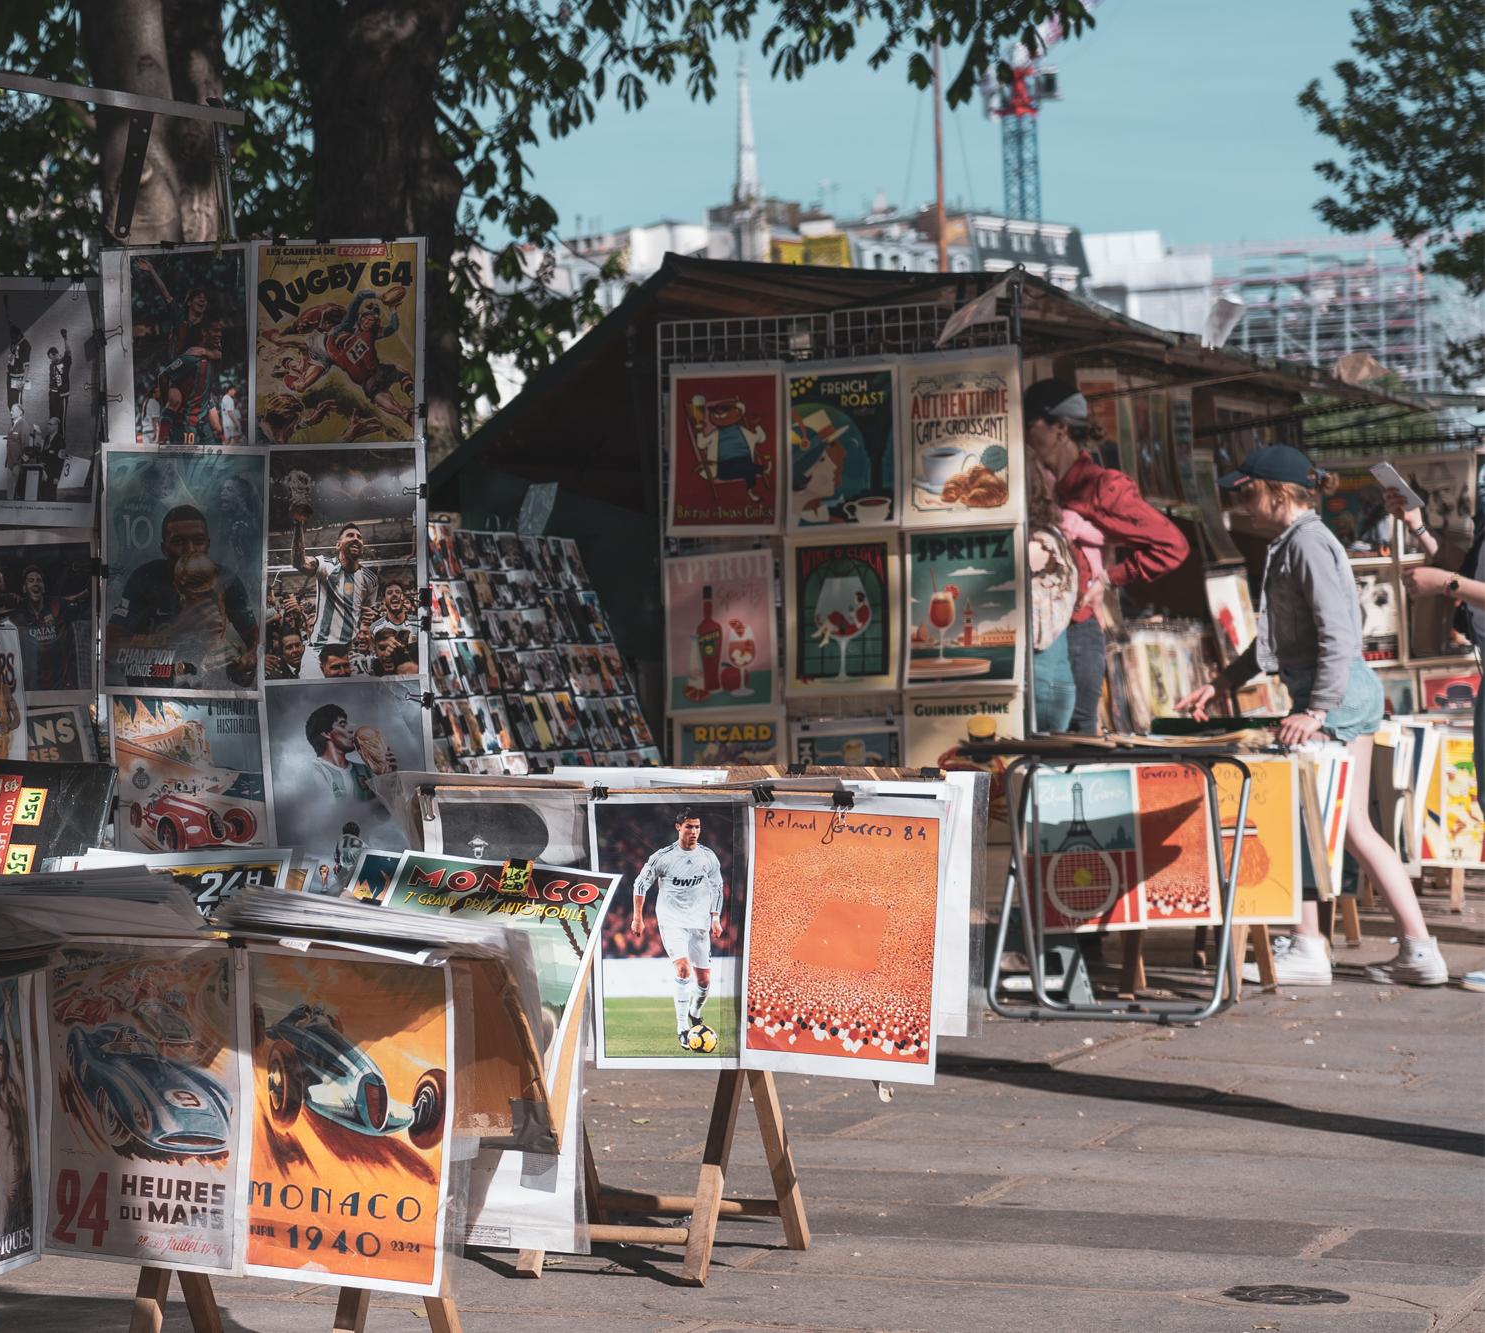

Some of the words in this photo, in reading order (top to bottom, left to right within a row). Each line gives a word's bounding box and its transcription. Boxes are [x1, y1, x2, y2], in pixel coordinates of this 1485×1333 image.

[258, 262, 367, 323] RUGBY
[371, 261, 413, 287] 64
[821, 380, 868, 395] FRENCH
[841, 391, 884, 408] ROAST
[911, 388, 1009, 420] AUTHENTIQUE
[183, 432, 195, 445] 10
[123, 515, 153, 549] 10
[916, 535, 1009, 562] SPRITZ
[669, 555, 768, 584] APEROL
[116, 648, 175, 664] CHAMPION
[124, 664, 152, 678] MONDE
[216, 701, 245, 716] GRAND
[914, 702, 977, 717] GUINNESS
[694, 725, 772, 743] RICARD
[1, 797, 16, 826] TOUS
[765, 810, 817, 832] Roland
[821, 807, 892, 845] Garros
[905, 826, 927, 841] 84
[672, 875, 704, 888] bwin
[418, 893, 457, 907] GRAND
[464, 896, 493, 912] PRIX
[498, 901, 586, 922] AUTOMOBILE
[53, 1168, 110, 1247] 24
[121, 1174, 226, 1206] HEURES
[248, 1181, 421, 1223] MONACO
[120, 1205, 143, 1221] DU
[148, 1202, 226, 1230] MANS
[201, 1242, 224, 1257] 1956
[287, 1224, 382, 1257] 1940
[391, 1240, 421, 1254] 23-24
